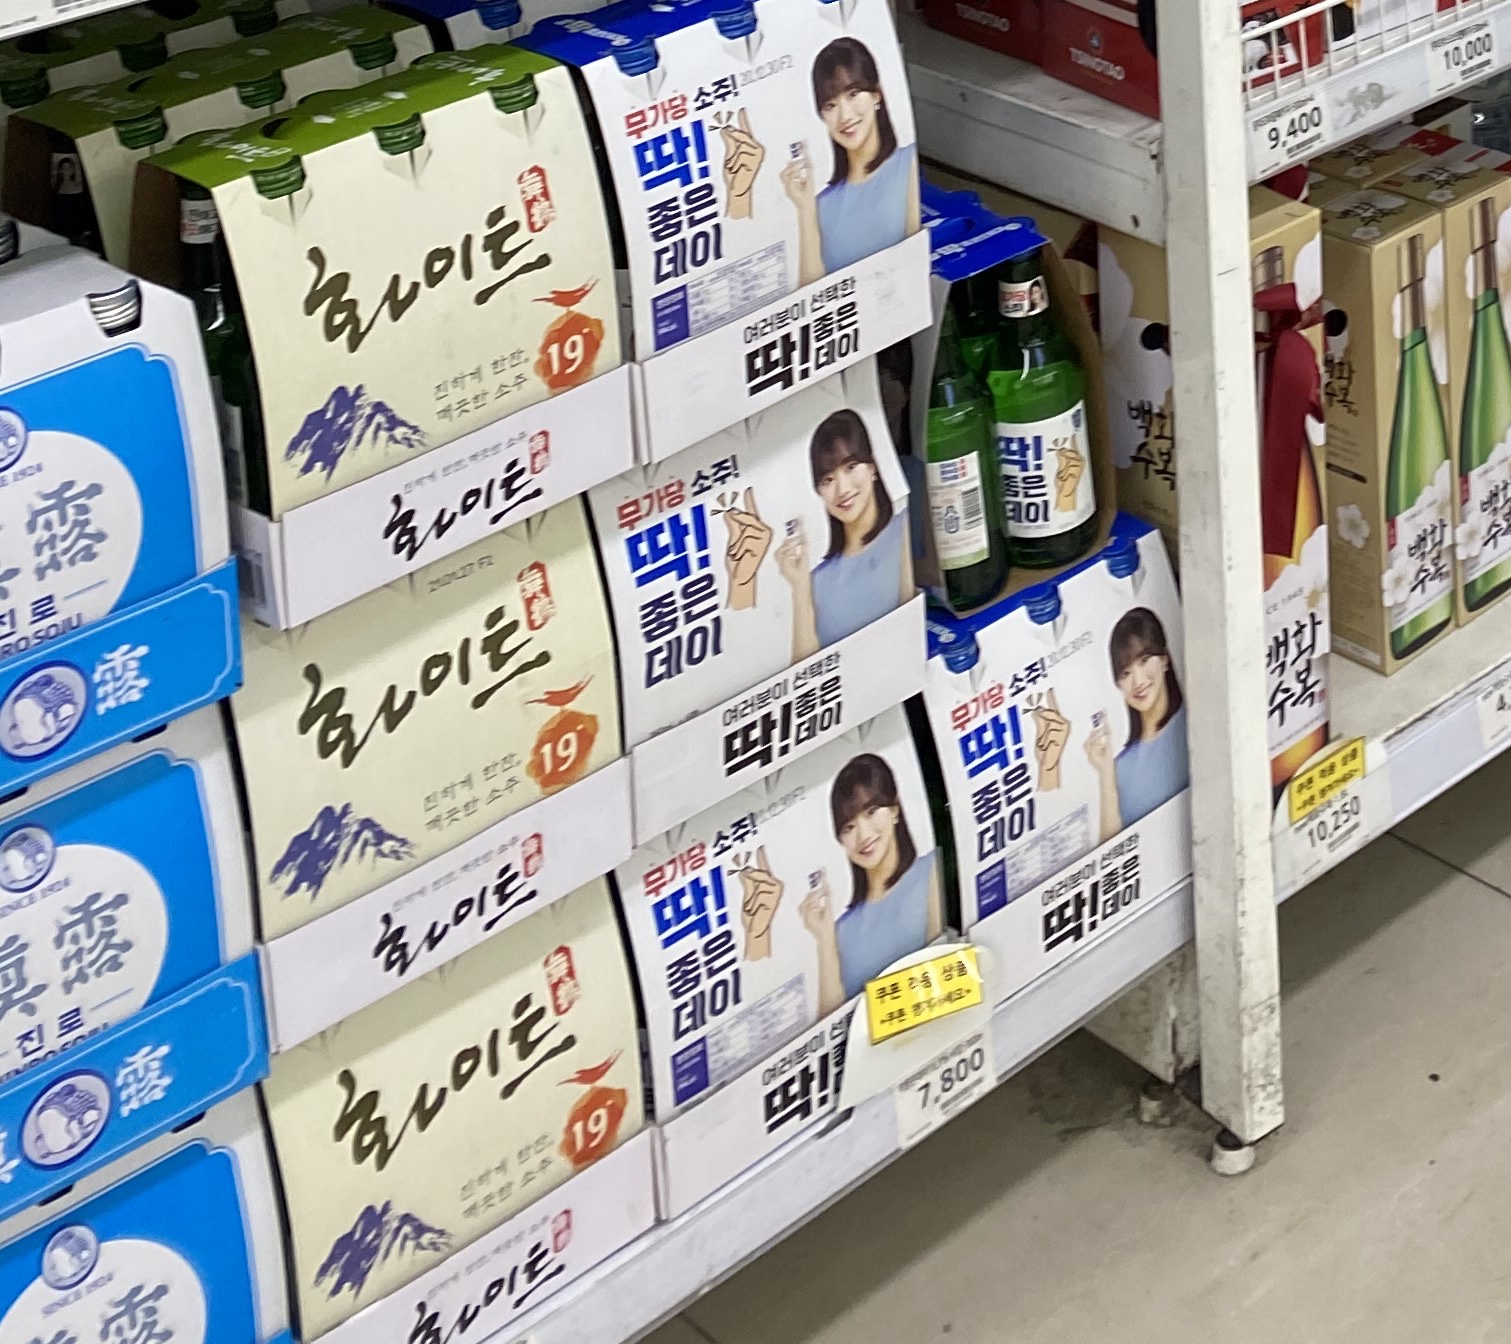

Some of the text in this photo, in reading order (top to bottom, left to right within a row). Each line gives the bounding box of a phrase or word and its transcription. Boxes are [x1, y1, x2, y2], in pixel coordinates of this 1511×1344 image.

[1444, 33, 1495, 70] 10,000
[624, 74, 739, 139] 무가당 소주!
[1267, 105, 1324, 150] 9,400
[633, 119, 710, 192] 딱!
[648, 182, 718, 243] 좋은
[654, 223, 723, 285] 데이
[493, 376, 527, 400] 소주
[546, 338, 583, 376] 19
[745, 323, 810, 397] 딱!
[617, 454, 740, 531] 무가당 소주!
[625, 505, 711, 588] 딱!
[1407, 517, 1449, 564] 백화
[1410, 550, 1449, 597] 수복
[640, 574, 718, 644] 좋은
[645, 618, 722, 689] 데이
[1266, 612, 1324, 674] 백화
[951, 658, 1048, 731] 무가당 소주!
[1267, 666, 1322, 726] 수복
[540, 737, 578, 773] 19
[724, 698, 792, 777] 딱!
[958, 705, 1026, 780] 딱!
[970, 761, 1033, 824] 좋은
[1307, 796, 1361, 850] 10,250
[643, 812, 758, 896] 무가당 소주!
[977, 796, 1038, 862] 데이
[651, 865, 728, 949] 딱!
[666, 930, 740, 999] 좋은
[673, 974, 741, 1041] 데이
[917, 1048, 985, 1109] 7,800
[570, 1112, 608, 1152] 19
